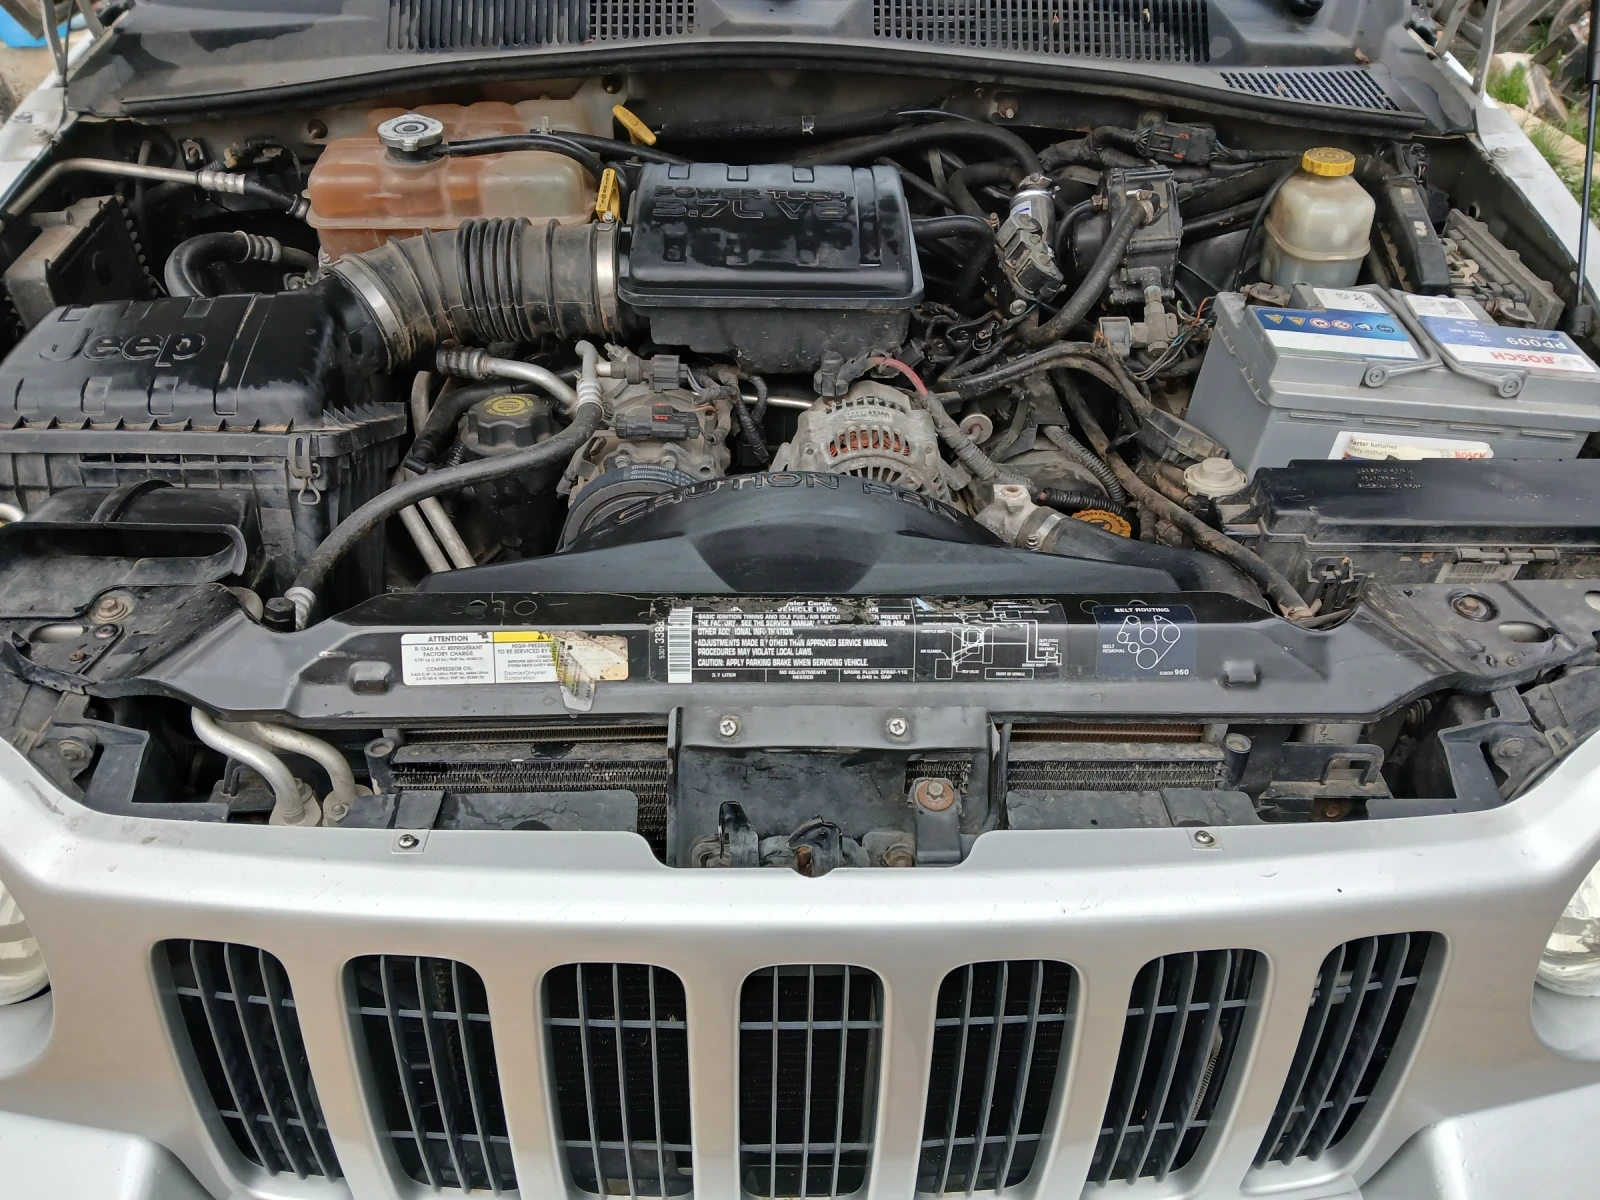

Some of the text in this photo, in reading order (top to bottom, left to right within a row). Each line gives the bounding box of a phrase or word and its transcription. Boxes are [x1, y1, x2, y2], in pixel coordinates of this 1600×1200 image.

[654, 186, 848, 200] POWER TECH
[653, 199, 848, 220] 3.7L V6
[39, 328, 206, 366] Jeep
[1506, 337, 1568, 350] PP009
[1490, 351, 1555, 364] BOSCH
[1370, 442, 1397, 450] batteries
[614, 474, 963, 525] CAUTION FAN
